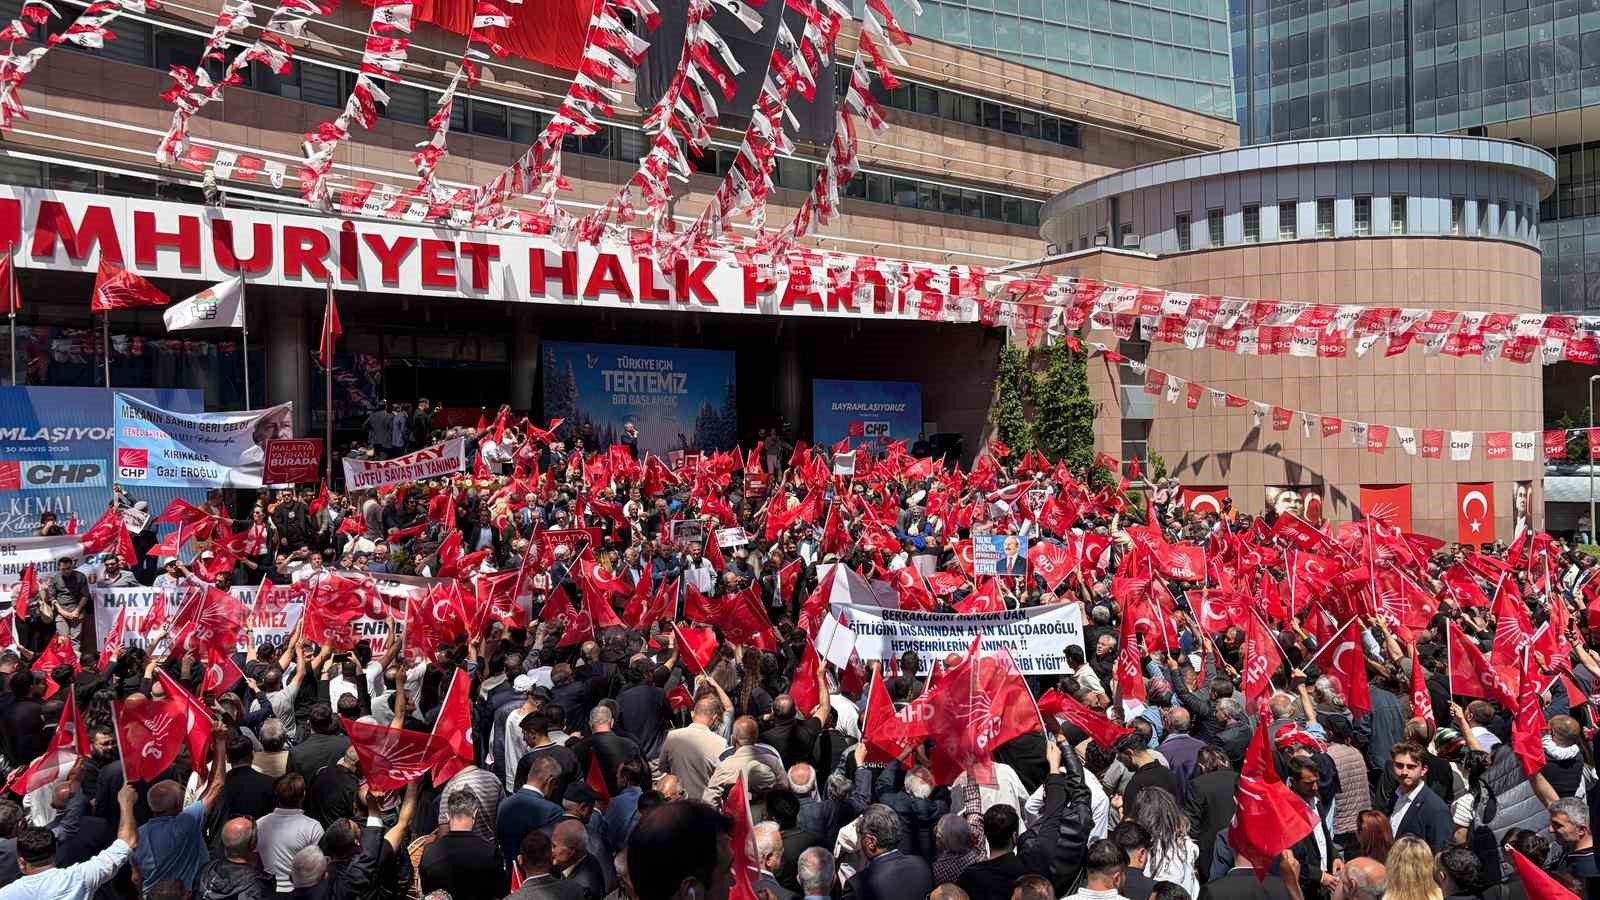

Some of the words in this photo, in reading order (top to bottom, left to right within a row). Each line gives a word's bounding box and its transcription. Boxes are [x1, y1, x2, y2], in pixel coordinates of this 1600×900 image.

[0, 199, 500, 293] MHURİYET
[528, 247, 719, 310] HALK
[601, 369, 689, 394] TERTEMİZ
[865, 423, 889, 434] CHP
[1422, 446, 1440, 454] CHP
[1450, 440, 1470, 449] CHP
[1514, 441, 1533, 449] CHP
[1545, 446, 1564, 454] CHP
[1487, 447, 1507, 455] CHP
[270, 457, 318, 466] BURADA
[27, 463, 101, 485] CHP
[120, 467, 146, 478] CHP
[156, 465, 179, 479] Gazi
[545, 533, 589, 542] ALATYA
[103, 592, 138, 608] HAK
[900, 622, 965, 637] İNSANINDAN
[998, 620, 1078, 639] KILIÇDAROĞLU,
[976, 639, 1018, 652] ANINDA
[1120, 649, 1138, 677] CHP
